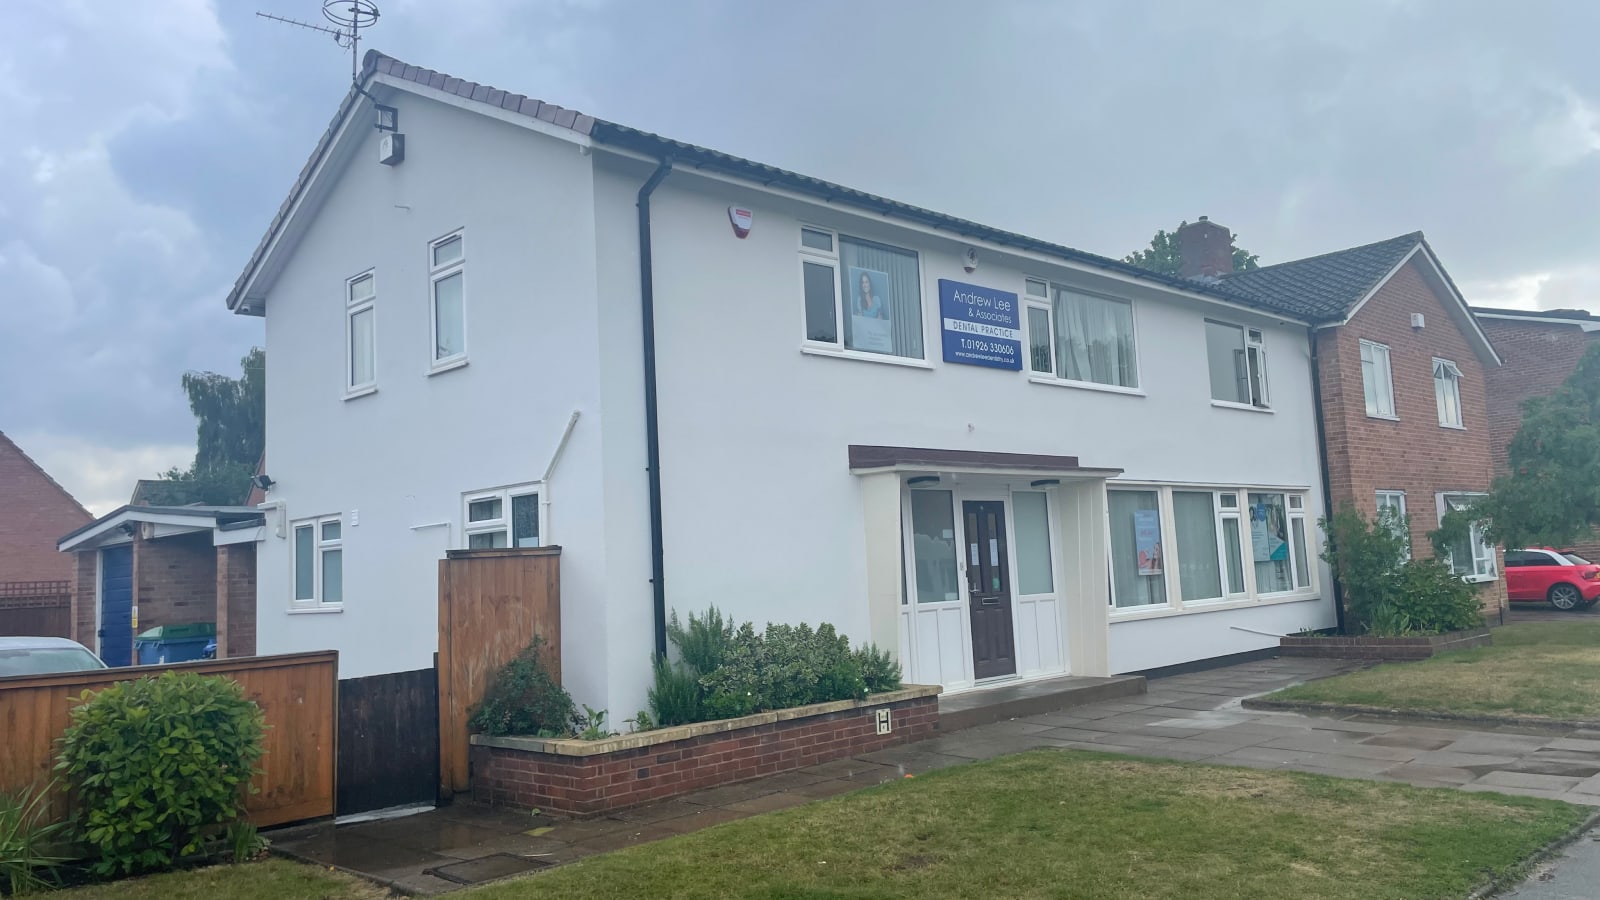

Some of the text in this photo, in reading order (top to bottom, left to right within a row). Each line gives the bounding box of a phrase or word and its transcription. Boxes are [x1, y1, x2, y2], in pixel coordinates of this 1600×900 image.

[953, 289, 1011, 311] Andrew Lee
[968, 307, 1012, 323] & Associates
[953, 320, 1013, 338] DENTAL PRACTICE
[990, 342, 1014, 355] 330606
[878, 711, 889, 732] H
